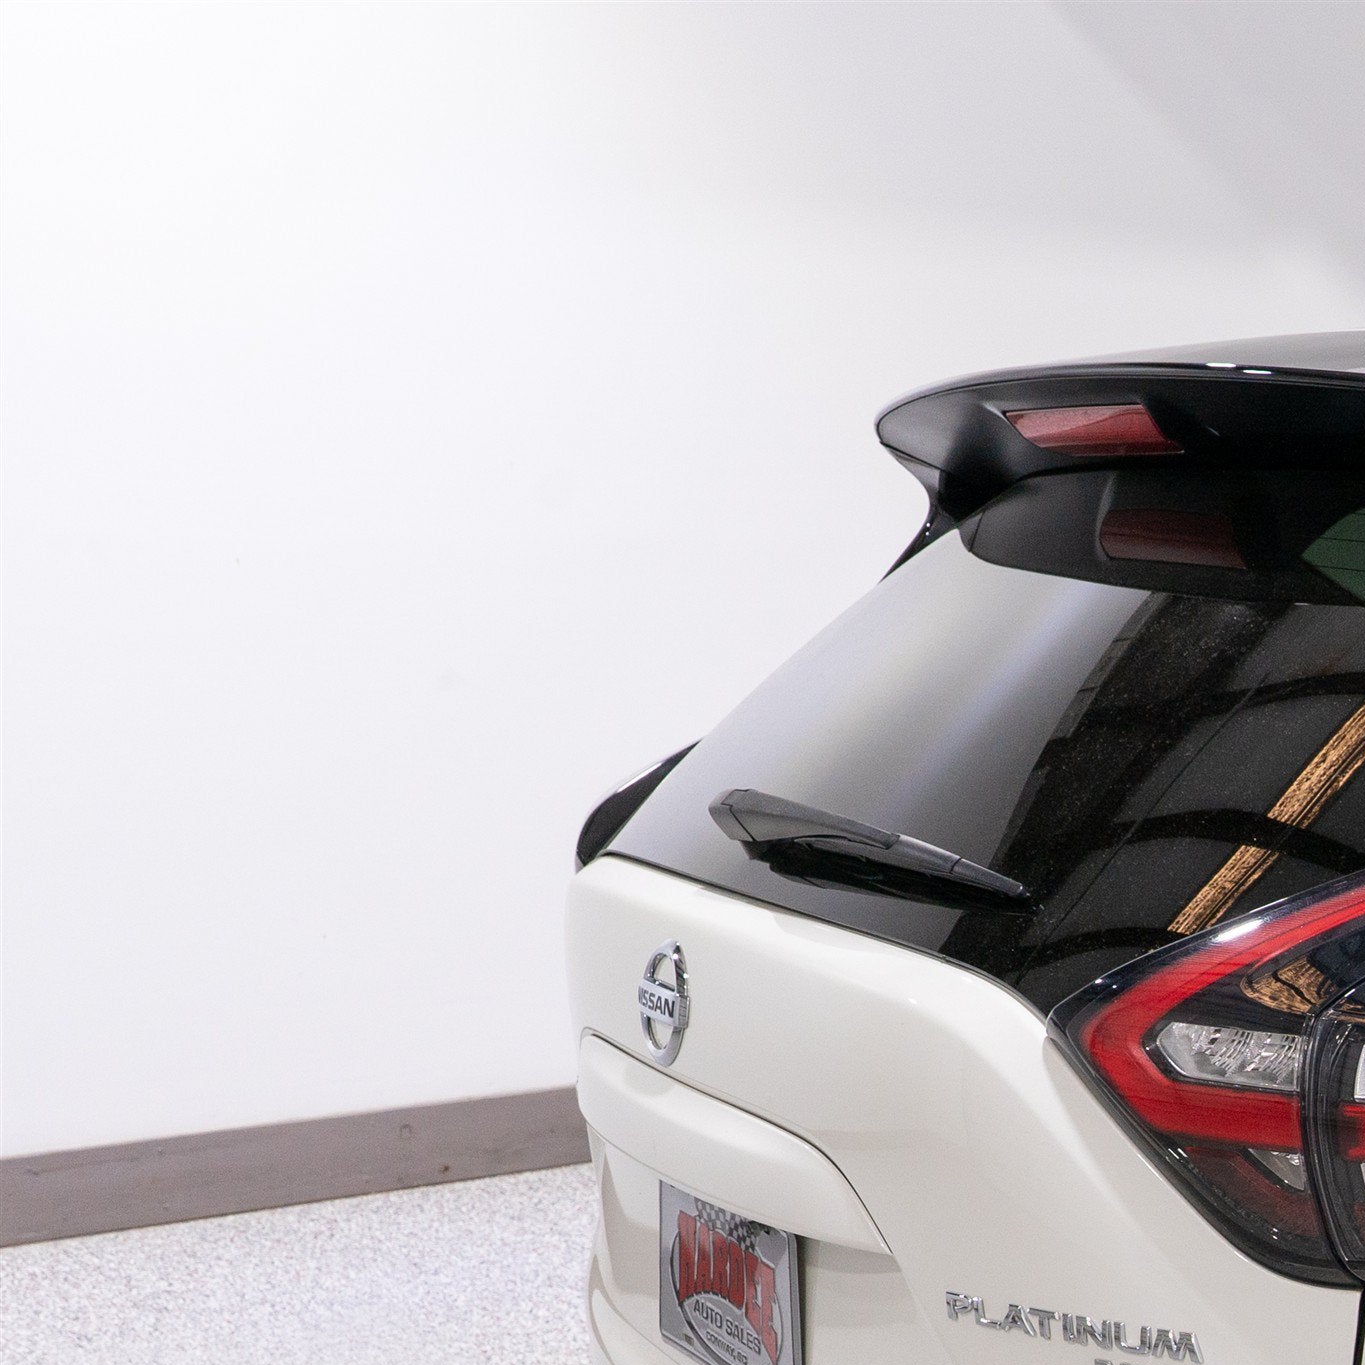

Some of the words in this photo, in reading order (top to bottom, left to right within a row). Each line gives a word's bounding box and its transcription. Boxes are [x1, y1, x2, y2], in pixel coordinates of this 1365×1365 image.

[638, 985, 676, 1018] NISSAN
[693, 1299, 723, 1329] AUTO
[725, 1318, 762, 1355] SALES
[945, 1291, 1204, 1364] PLATINUM
